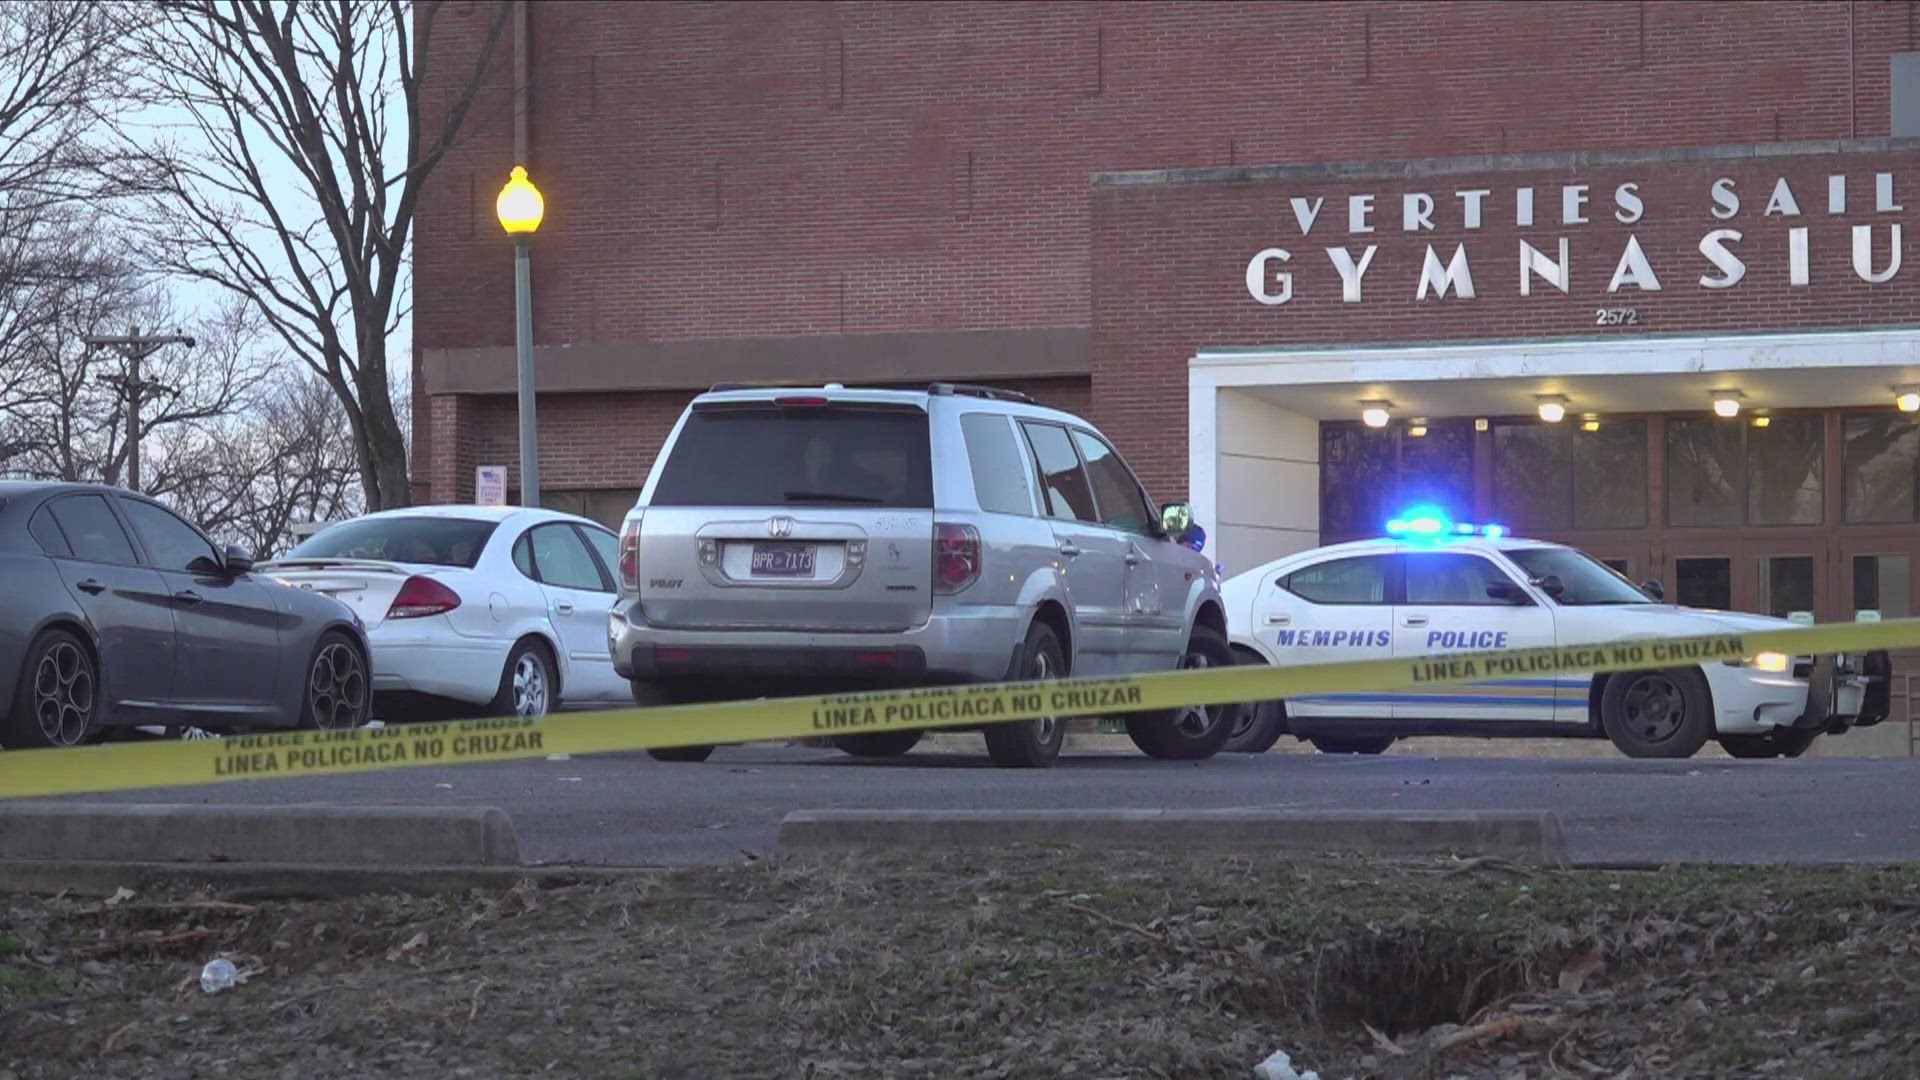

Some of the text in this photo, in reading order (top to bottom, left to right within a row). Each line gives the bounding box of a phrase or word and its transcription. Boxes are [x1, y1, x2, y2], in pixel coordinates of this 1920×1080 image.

[1290, 172, 1904, 236] VERTIES SAIL
[1246, 223, 1902, 306] GYMNASIU
[1596, 309, 1638, 326] 2572
[753, 551, 812, 570] BPR 7173
[1276, 629, 1391, 648] MEMPHIS
[1426, 630, 1509, 649] POLICE
[1411, 660, 1478, 682] LINEA
[1613, 645, 1644, 665] NO
[1651, 636, 1745, 661] CRUZAR
[812, 705, 877, 730] LINEA
[1012, 693, 1043, 715] NO
[1050, 685, 1143, 711] CRUZAR
[214, 731, 544, 776] LINEA POLICIACA NO CRUZAR
